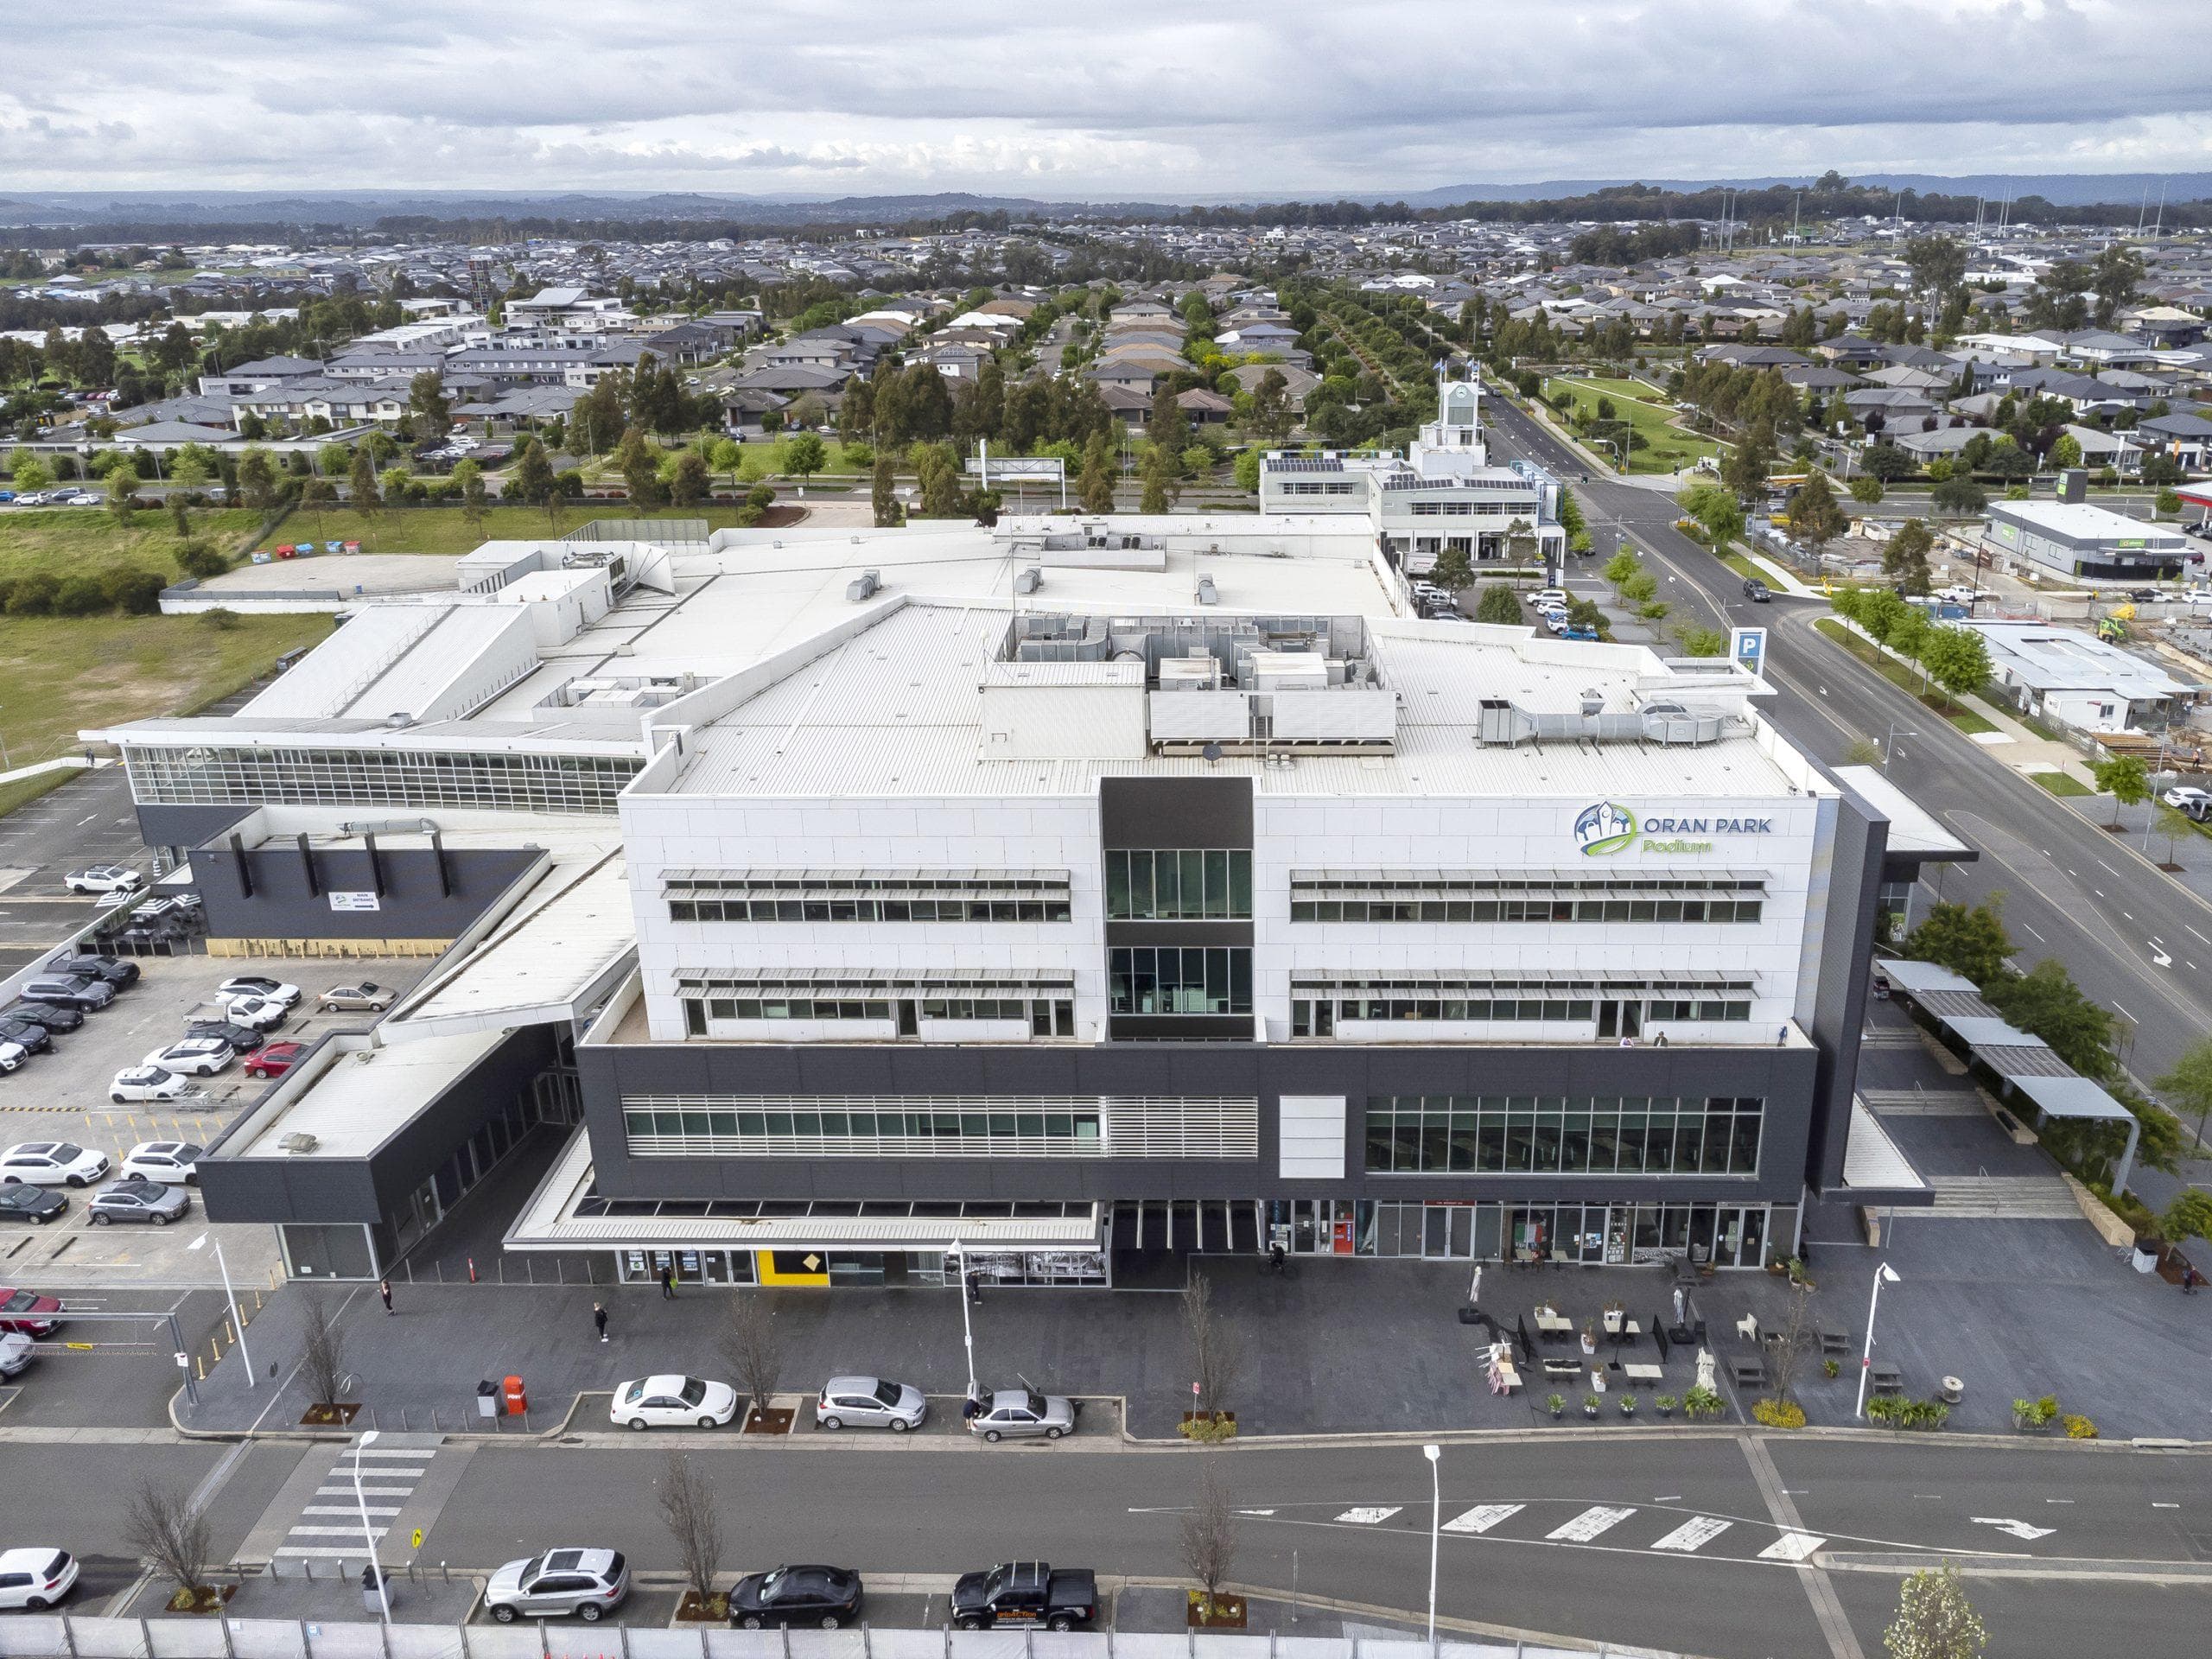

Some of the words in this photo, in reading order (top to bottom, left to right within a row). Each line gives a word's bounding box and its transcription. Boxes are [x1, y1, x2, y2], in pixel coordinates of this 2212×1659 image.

[1742, 638, 1757, 654] P
[1644, 818, 1707, 833] ORAN
[1715, 818, 1771, 833] PARK
[1643, 839, 1712, 853] Podium
